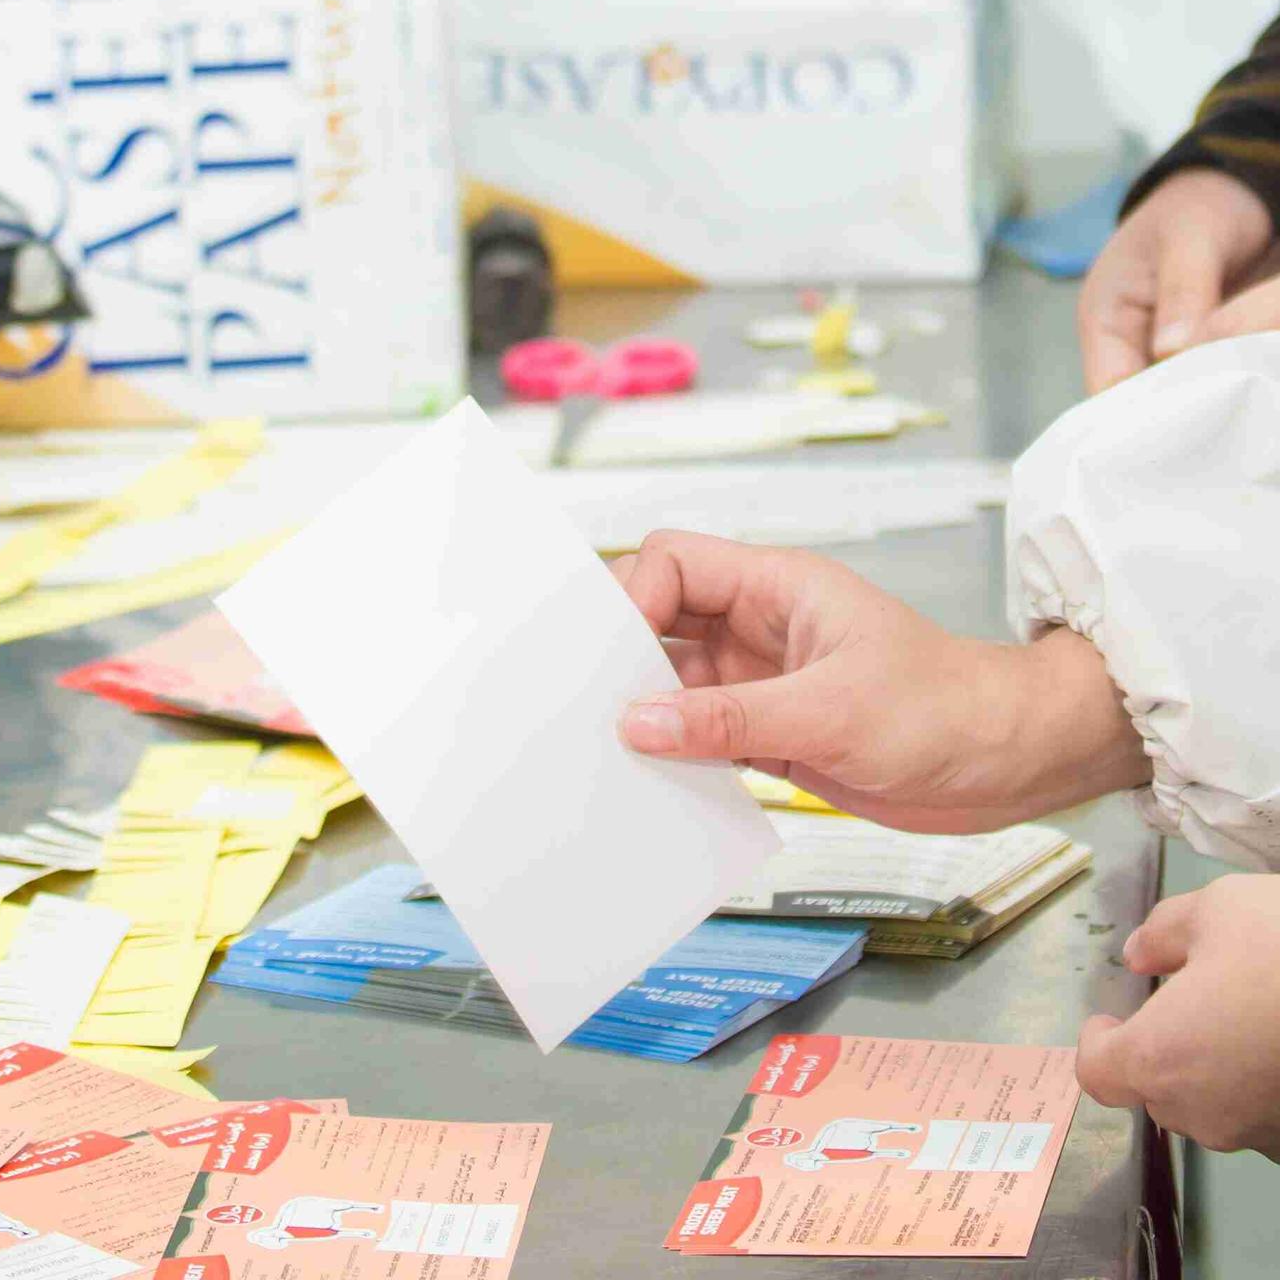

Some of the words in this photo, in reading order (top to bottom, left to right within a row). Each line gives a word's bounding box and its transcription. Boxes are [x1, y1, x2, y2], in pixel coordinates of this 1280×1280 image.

[791, 896, 847, 906] MEAT
[847, 897, 910, 907] SHEEP
[827, 905, 905, 915] FROZEN
[664, 973, 720, 984] MEAT
[721, 978, 785, 990] SHEEP
[701, 983, 780, 995] FROZEN
[644, 994, 720, 1009] FROZEN
[668, 990, 730, 1003] SHEEP
[699, 1208, 727, 1236] SHEEP
[713, 1185, 741, 1208] MEAT
[679, 1203, 711, 1236] FROZEN
